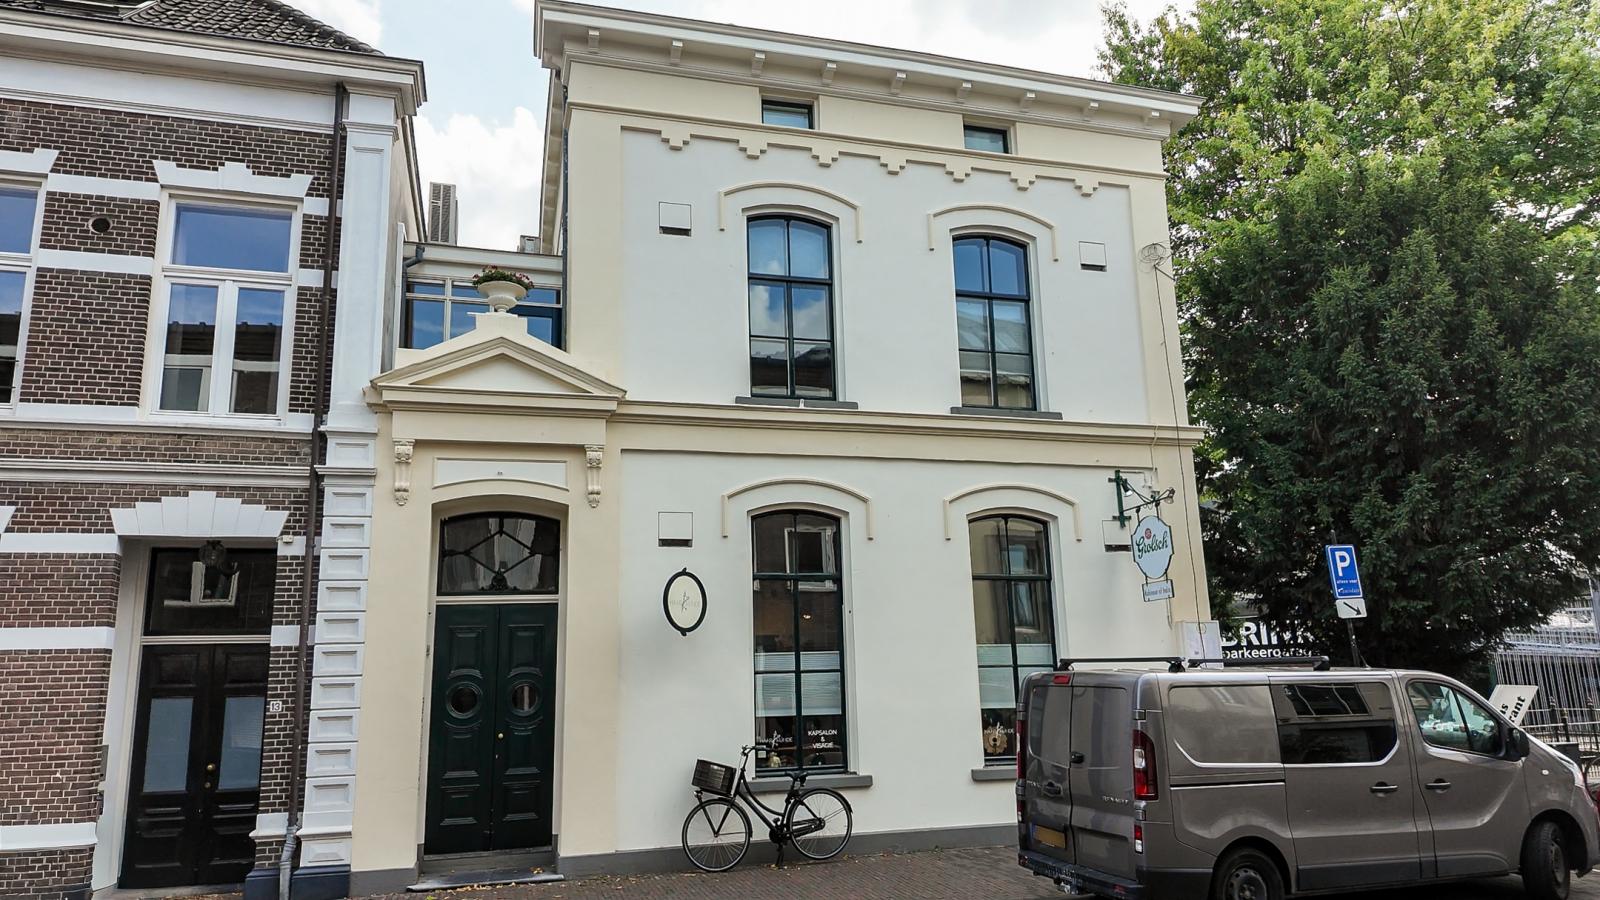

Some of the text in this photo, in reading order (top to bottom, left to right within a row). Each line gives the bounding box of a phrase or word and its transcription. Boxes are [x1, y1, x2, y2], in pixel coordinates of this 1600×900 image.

[1136, 530, 1168, 559] Grolsch
[1335, 551, 1350, 576] P
[271, 702, 280, 710] 13
